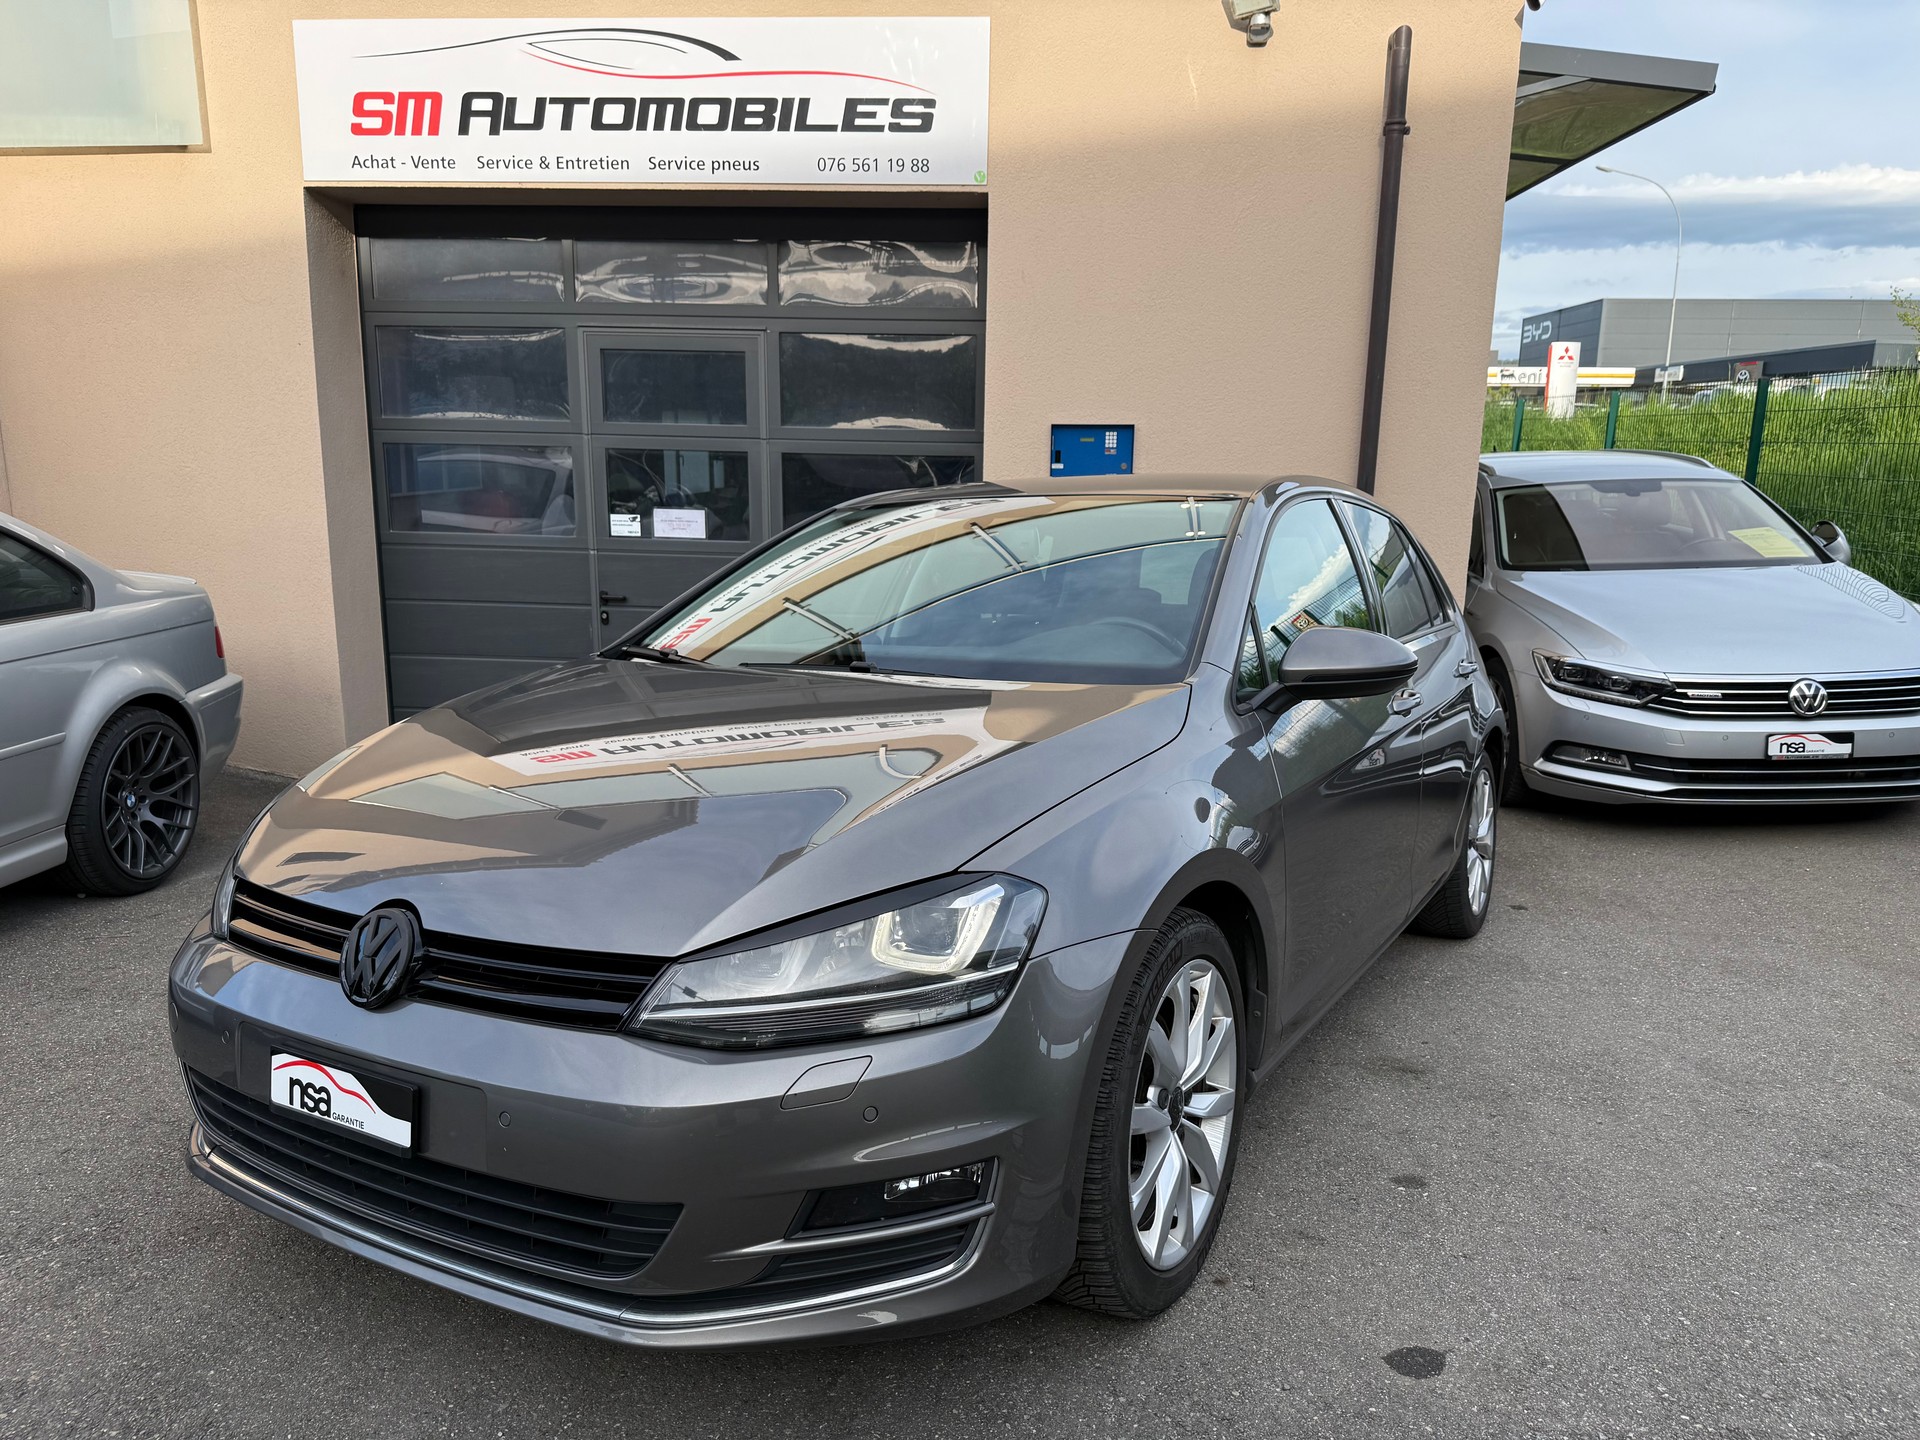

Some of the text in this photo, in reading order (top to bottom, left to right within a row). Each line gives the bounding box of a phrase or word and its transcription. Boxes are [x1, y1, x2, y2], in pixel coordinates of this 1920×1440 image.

[350, 91, 937, 137] SM AUTOMOBILES
[351, 154, 397, 169] Achat
[410, 155, 456, 170] Vente
[476, 154, 630, 171] Service & Entretien
[648, 155, 760, 175] Service pneus
[817, 157, 930, 173] 076 561 19 88
[1523, 320, 1552, 344] BYD
[1518, 369, 1543, 385] eni
[1779, 742, 1806, 754] nsa
[289, 1076, 332, 1119] nsa
[331, 1111, 366, 1130] GARANTIE
